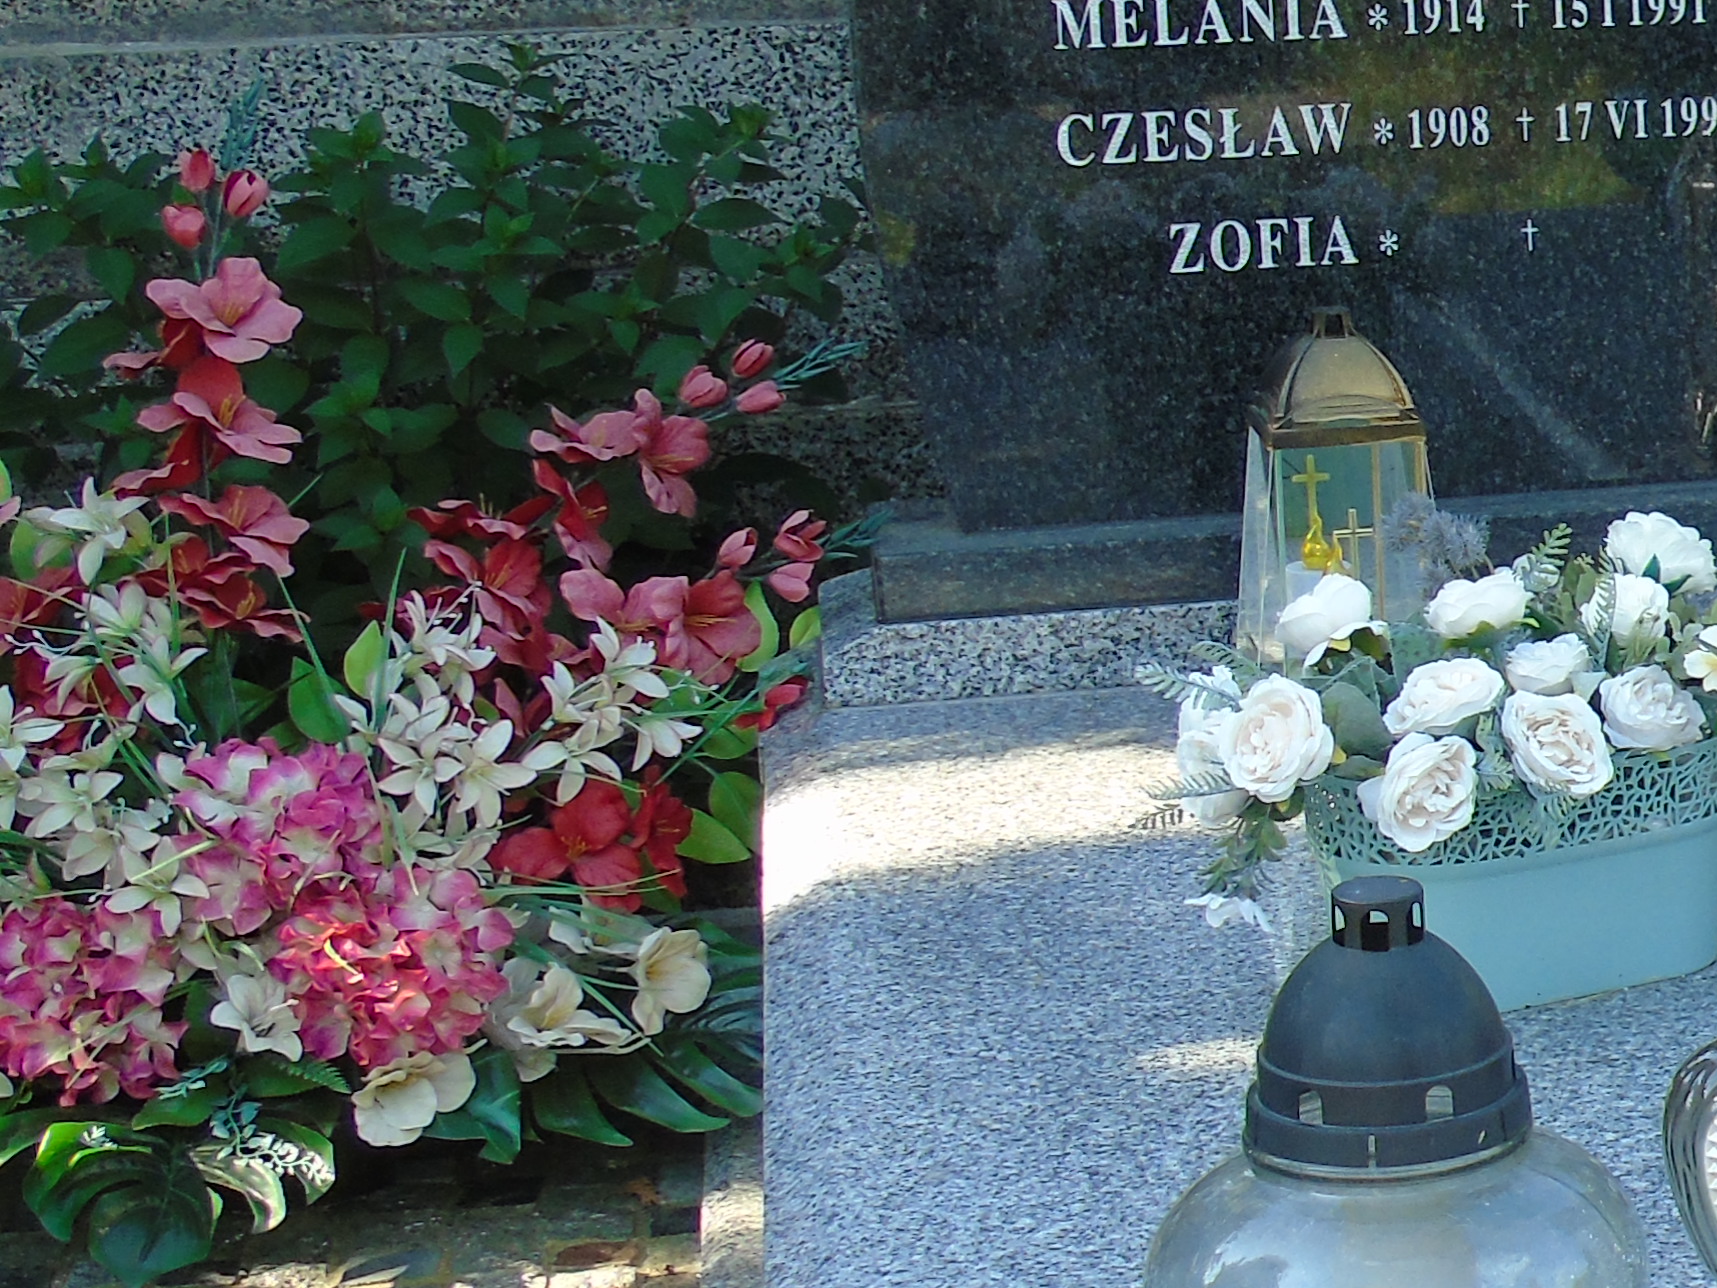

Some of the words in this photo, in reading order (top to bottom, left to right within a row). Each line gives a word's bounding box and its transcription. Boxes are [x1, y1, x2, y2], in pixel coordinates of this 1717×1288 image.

[1056, 102, 1353, 167] CZESŁAW
[1408, 106, 1491, 150] 1908
[1555, 101, 1593, 144] 17
[1605, 99, 1649, 139] VI
[1168, 215, 1359, 274] ZOFIA
